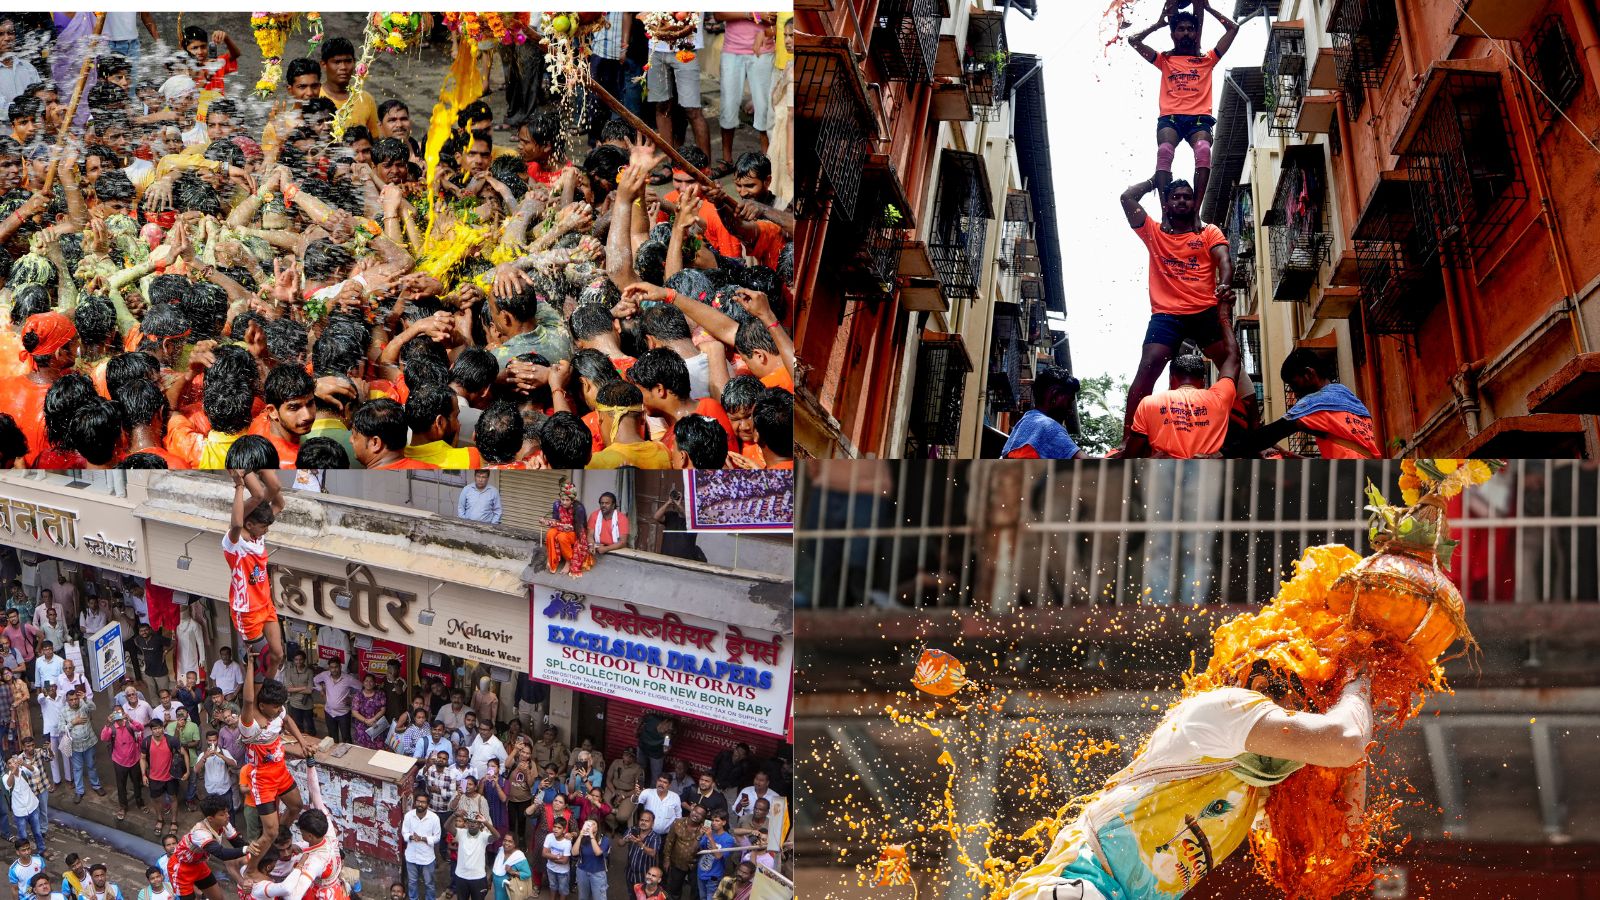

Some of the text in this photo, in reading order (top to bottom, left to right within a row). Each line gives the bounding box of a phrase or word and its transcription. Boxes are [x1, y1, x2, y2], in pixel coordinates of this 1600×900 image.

[439, 637, 521, 663] Men's Ethnic Wear
[447, 618, 513, 644] Mahavir
[590, 603, 718, 652] एक्सेलसियर
[547, 624, 774, 690] EXCELSIOR DRAPERS
[562, 646, 757, 700] SCHOOL UNIFORMS
[543, 668, 582, 681] COMPOSITION
[583, 677, 608, 686] TAXABLE
[610, 684, 633, 693] PERSON
[648, 692, 674, 703] ELIGIBLE
[685, 700, 713, 711] COLLECT
[738, 713, 768, 724] SUPPLIES
[546, 658, 772, 717] SPL.COLLECTION FOR NEW BORN BABY
[684, 729, 757, 754] INNERWER
